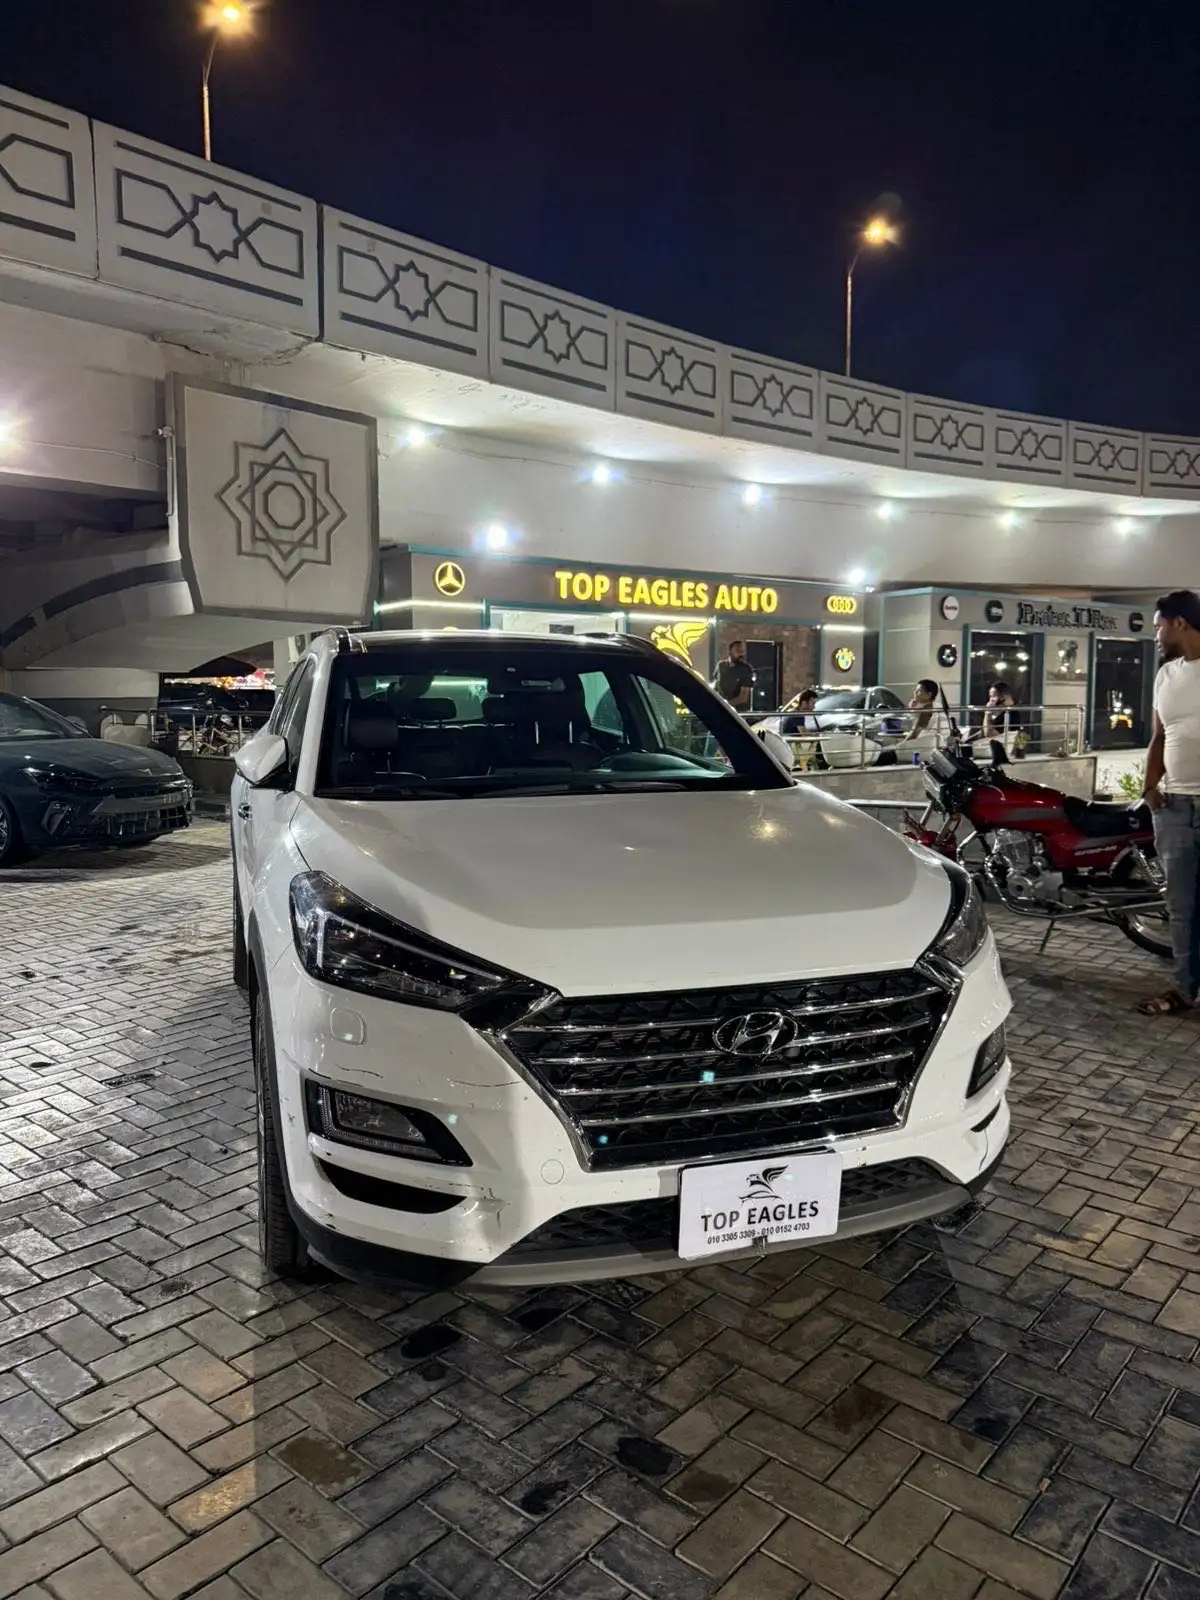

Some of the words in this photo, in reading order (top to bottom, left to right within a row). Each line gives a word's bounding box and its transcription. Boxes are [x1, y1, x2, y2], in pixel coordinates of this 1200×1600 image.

[555, 571, 610, 601] TOP
[618, 576, 709, 608] EAGLES
[714, 584, 778, 614] AUTO
[701, 1210, 740, 1232] TOP
[747, 1200, 819, 1225] EAGLES
[707, 1235, 720, 1245] 010
[721, 1232, 738, 1242] 3305
[739, 1229, 756, 1239] 3309
[761, 1226, 774, 1236] 010
[775, 1224, 792, 1234] 0152
[793, 1222, 810, 1232] 4703
